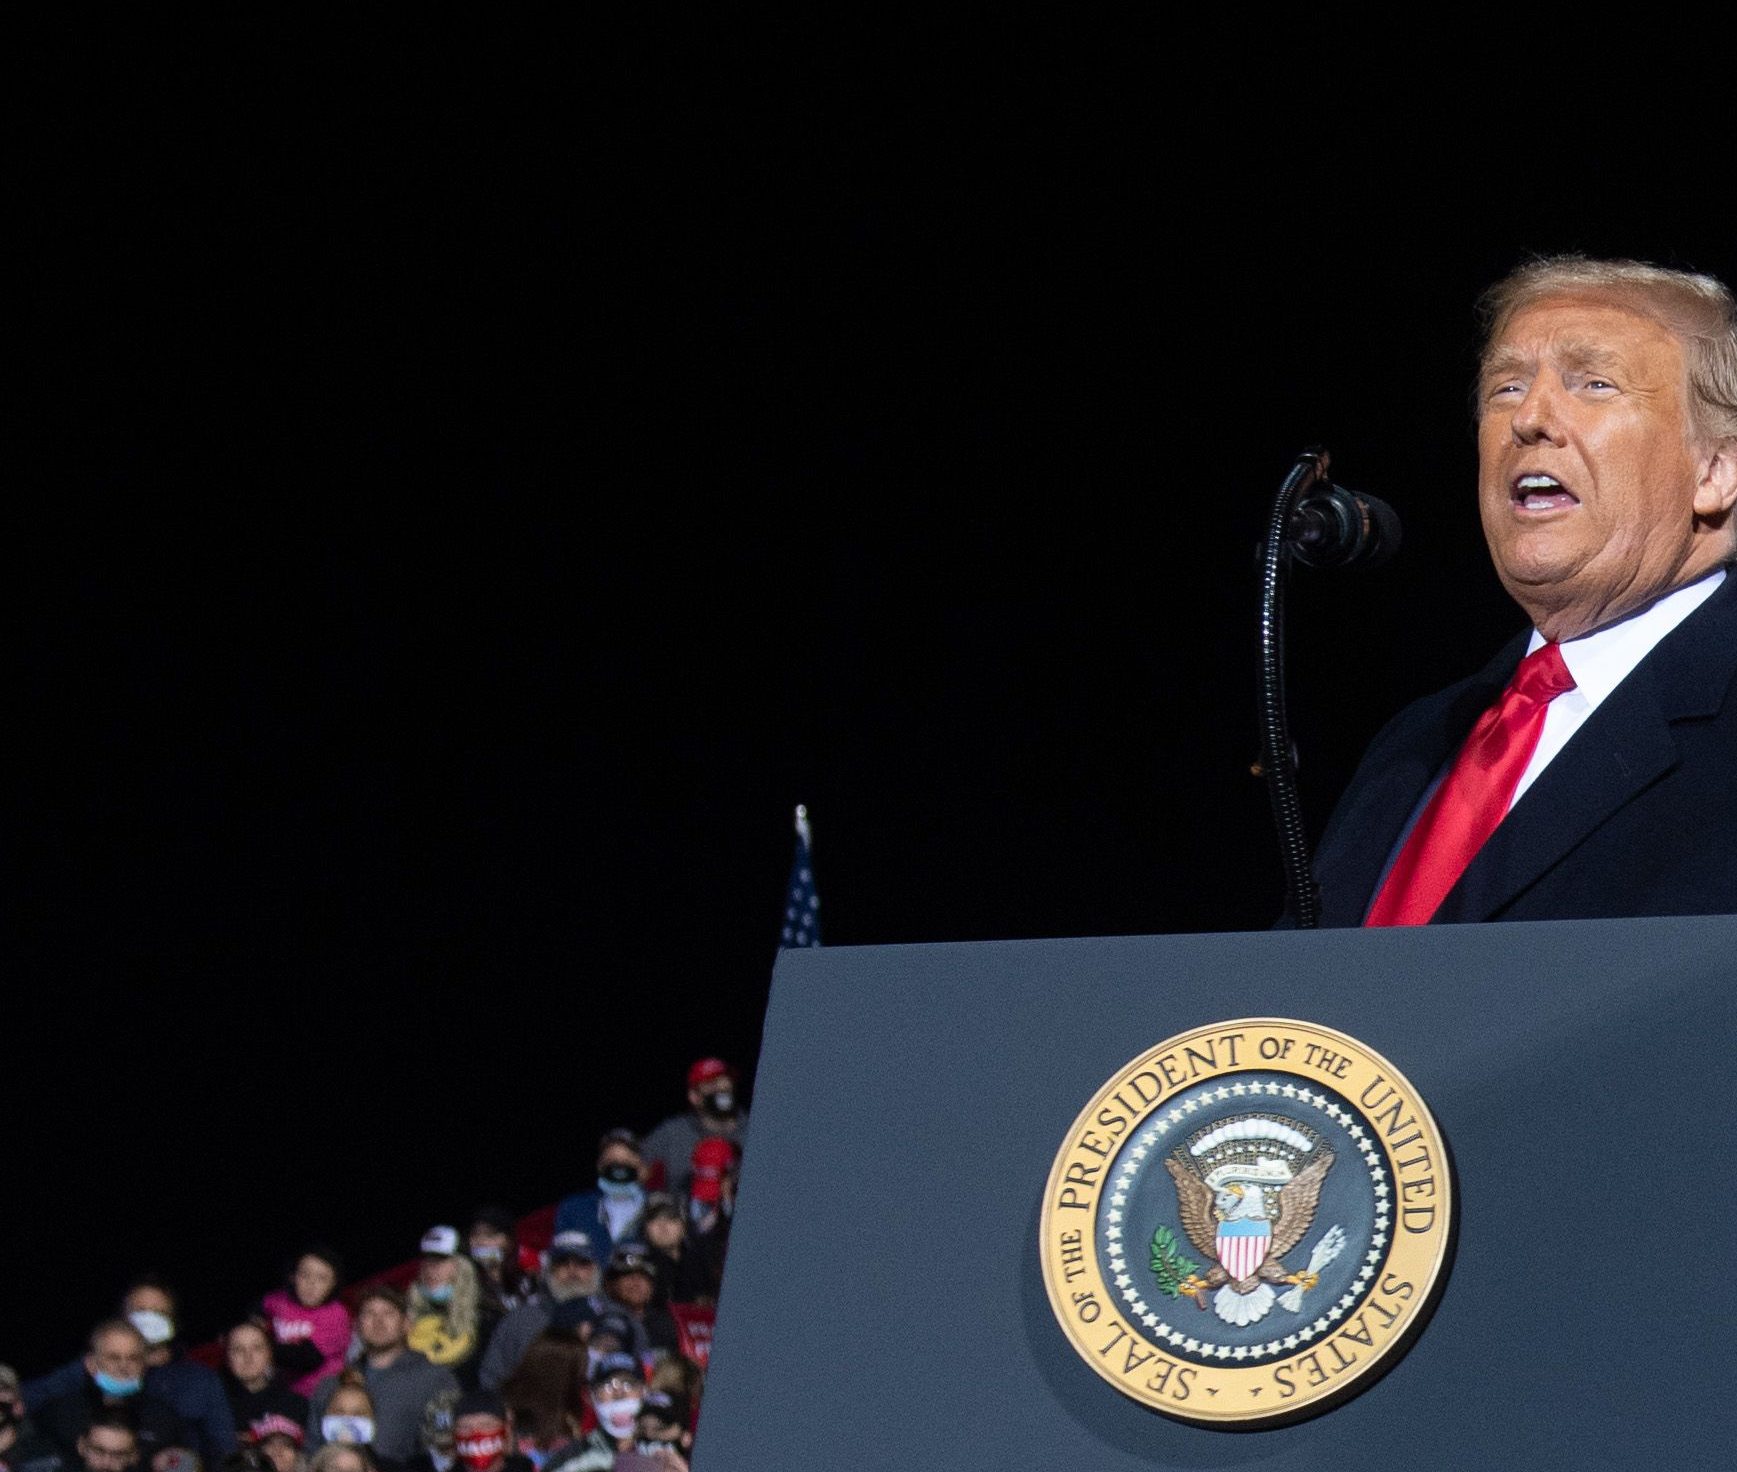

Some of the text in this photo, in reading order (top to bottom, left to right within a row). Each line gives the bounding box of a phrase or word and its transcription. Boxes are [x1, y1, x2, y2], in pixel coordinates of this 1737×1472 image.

[1058, 1033, 1436, 1399] SEAL OF THE PRESIDENT OF THE UNITED STATES
